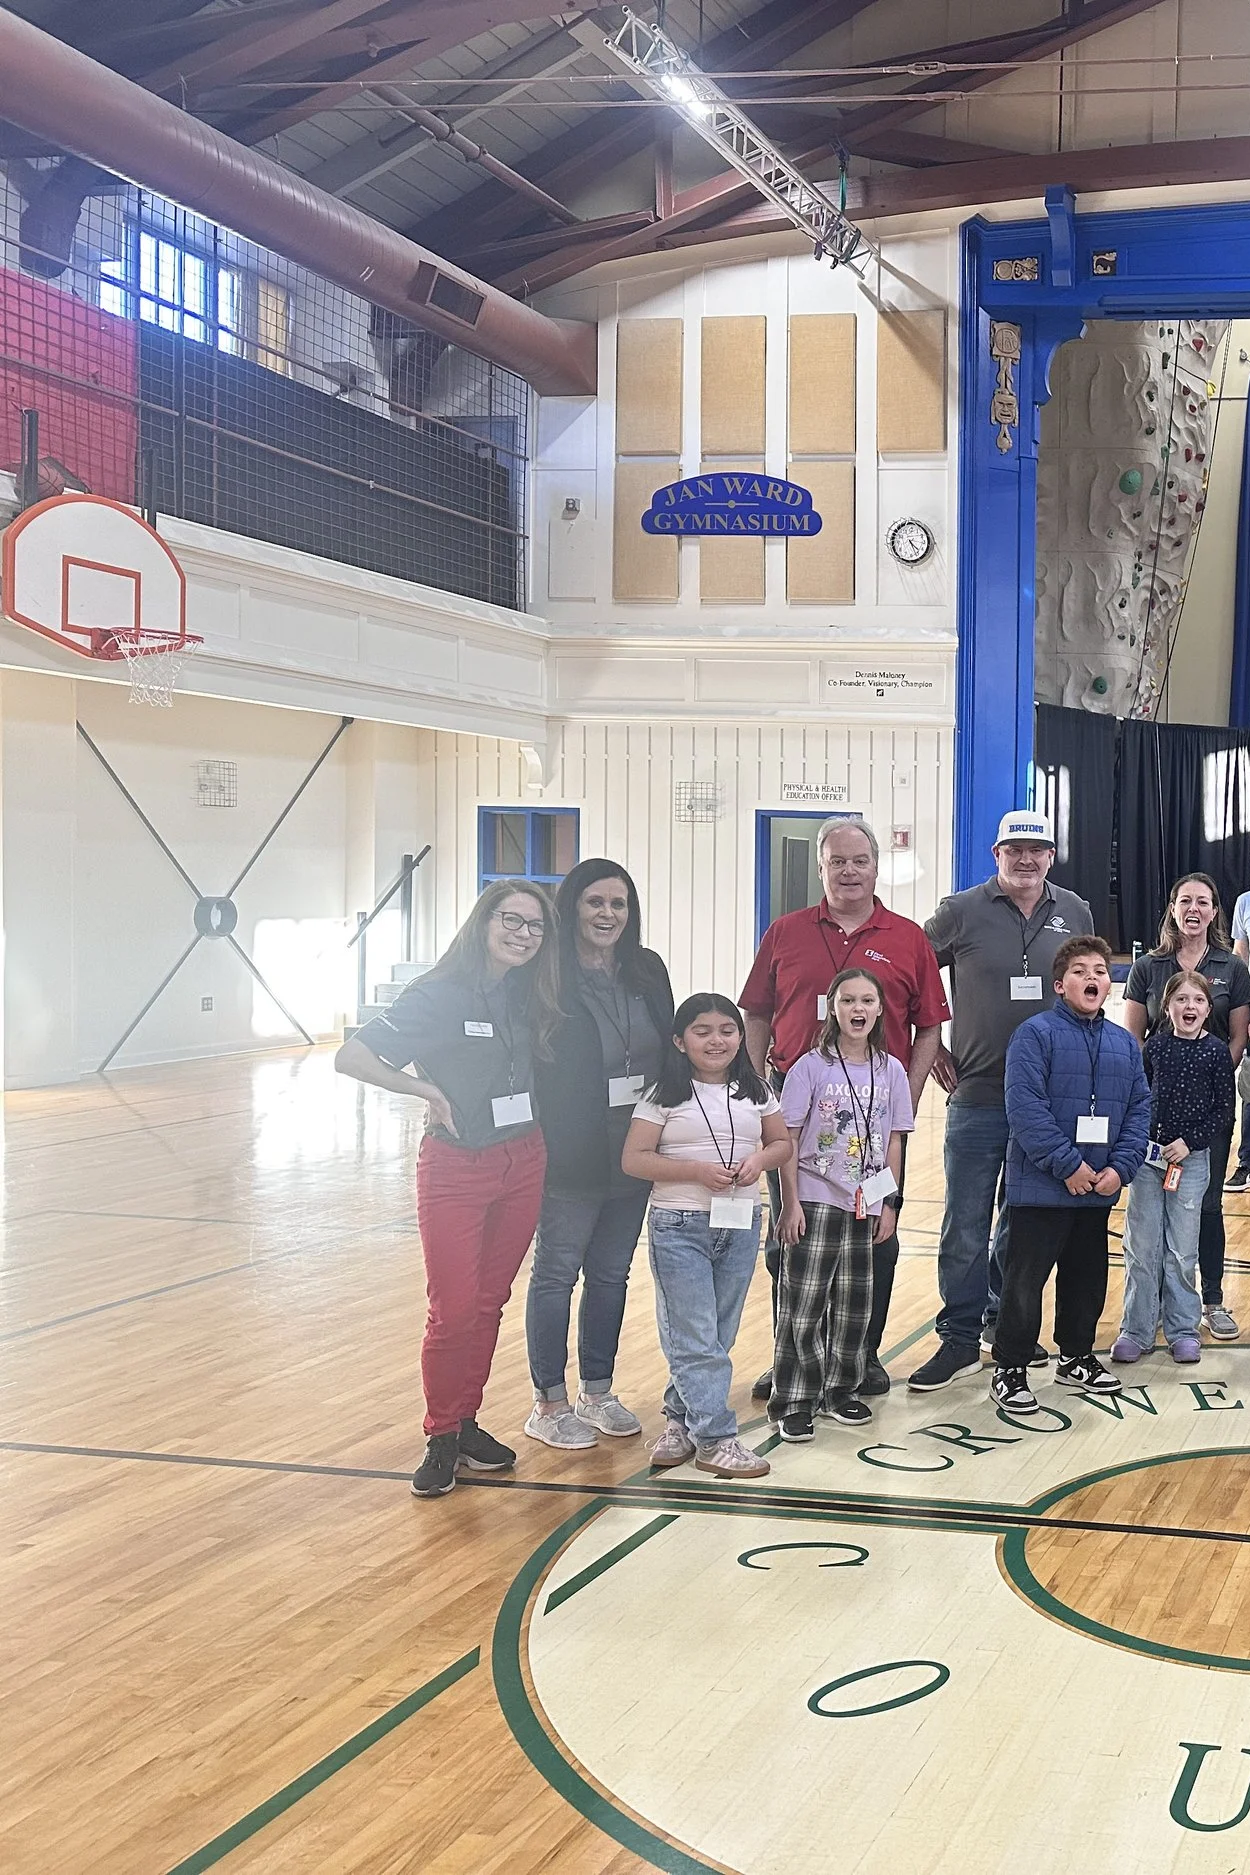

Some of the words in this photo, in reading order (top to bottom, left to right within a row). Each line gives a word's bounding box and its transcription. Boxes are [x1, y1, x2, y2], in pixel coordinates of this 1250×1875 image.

[664, 478, 714, 507] JAN
[722, 476, 803, 507] WARD
[653, 512, 811, 531] GYMNASIUM
[878, 672, 906, 680] Maloney
[867, 680, 900, 688] Visionary,
[900, 680, 933, 689] Champion
[783, 783, 813, 792] PHYSICAL
[821, 785, 847, 793] HEALTH
[786, 791, 820, 800] EDUCATION
[821, 793, 844, 801] OFFICE
[1008, 824, 1044, 834] BRUINS
